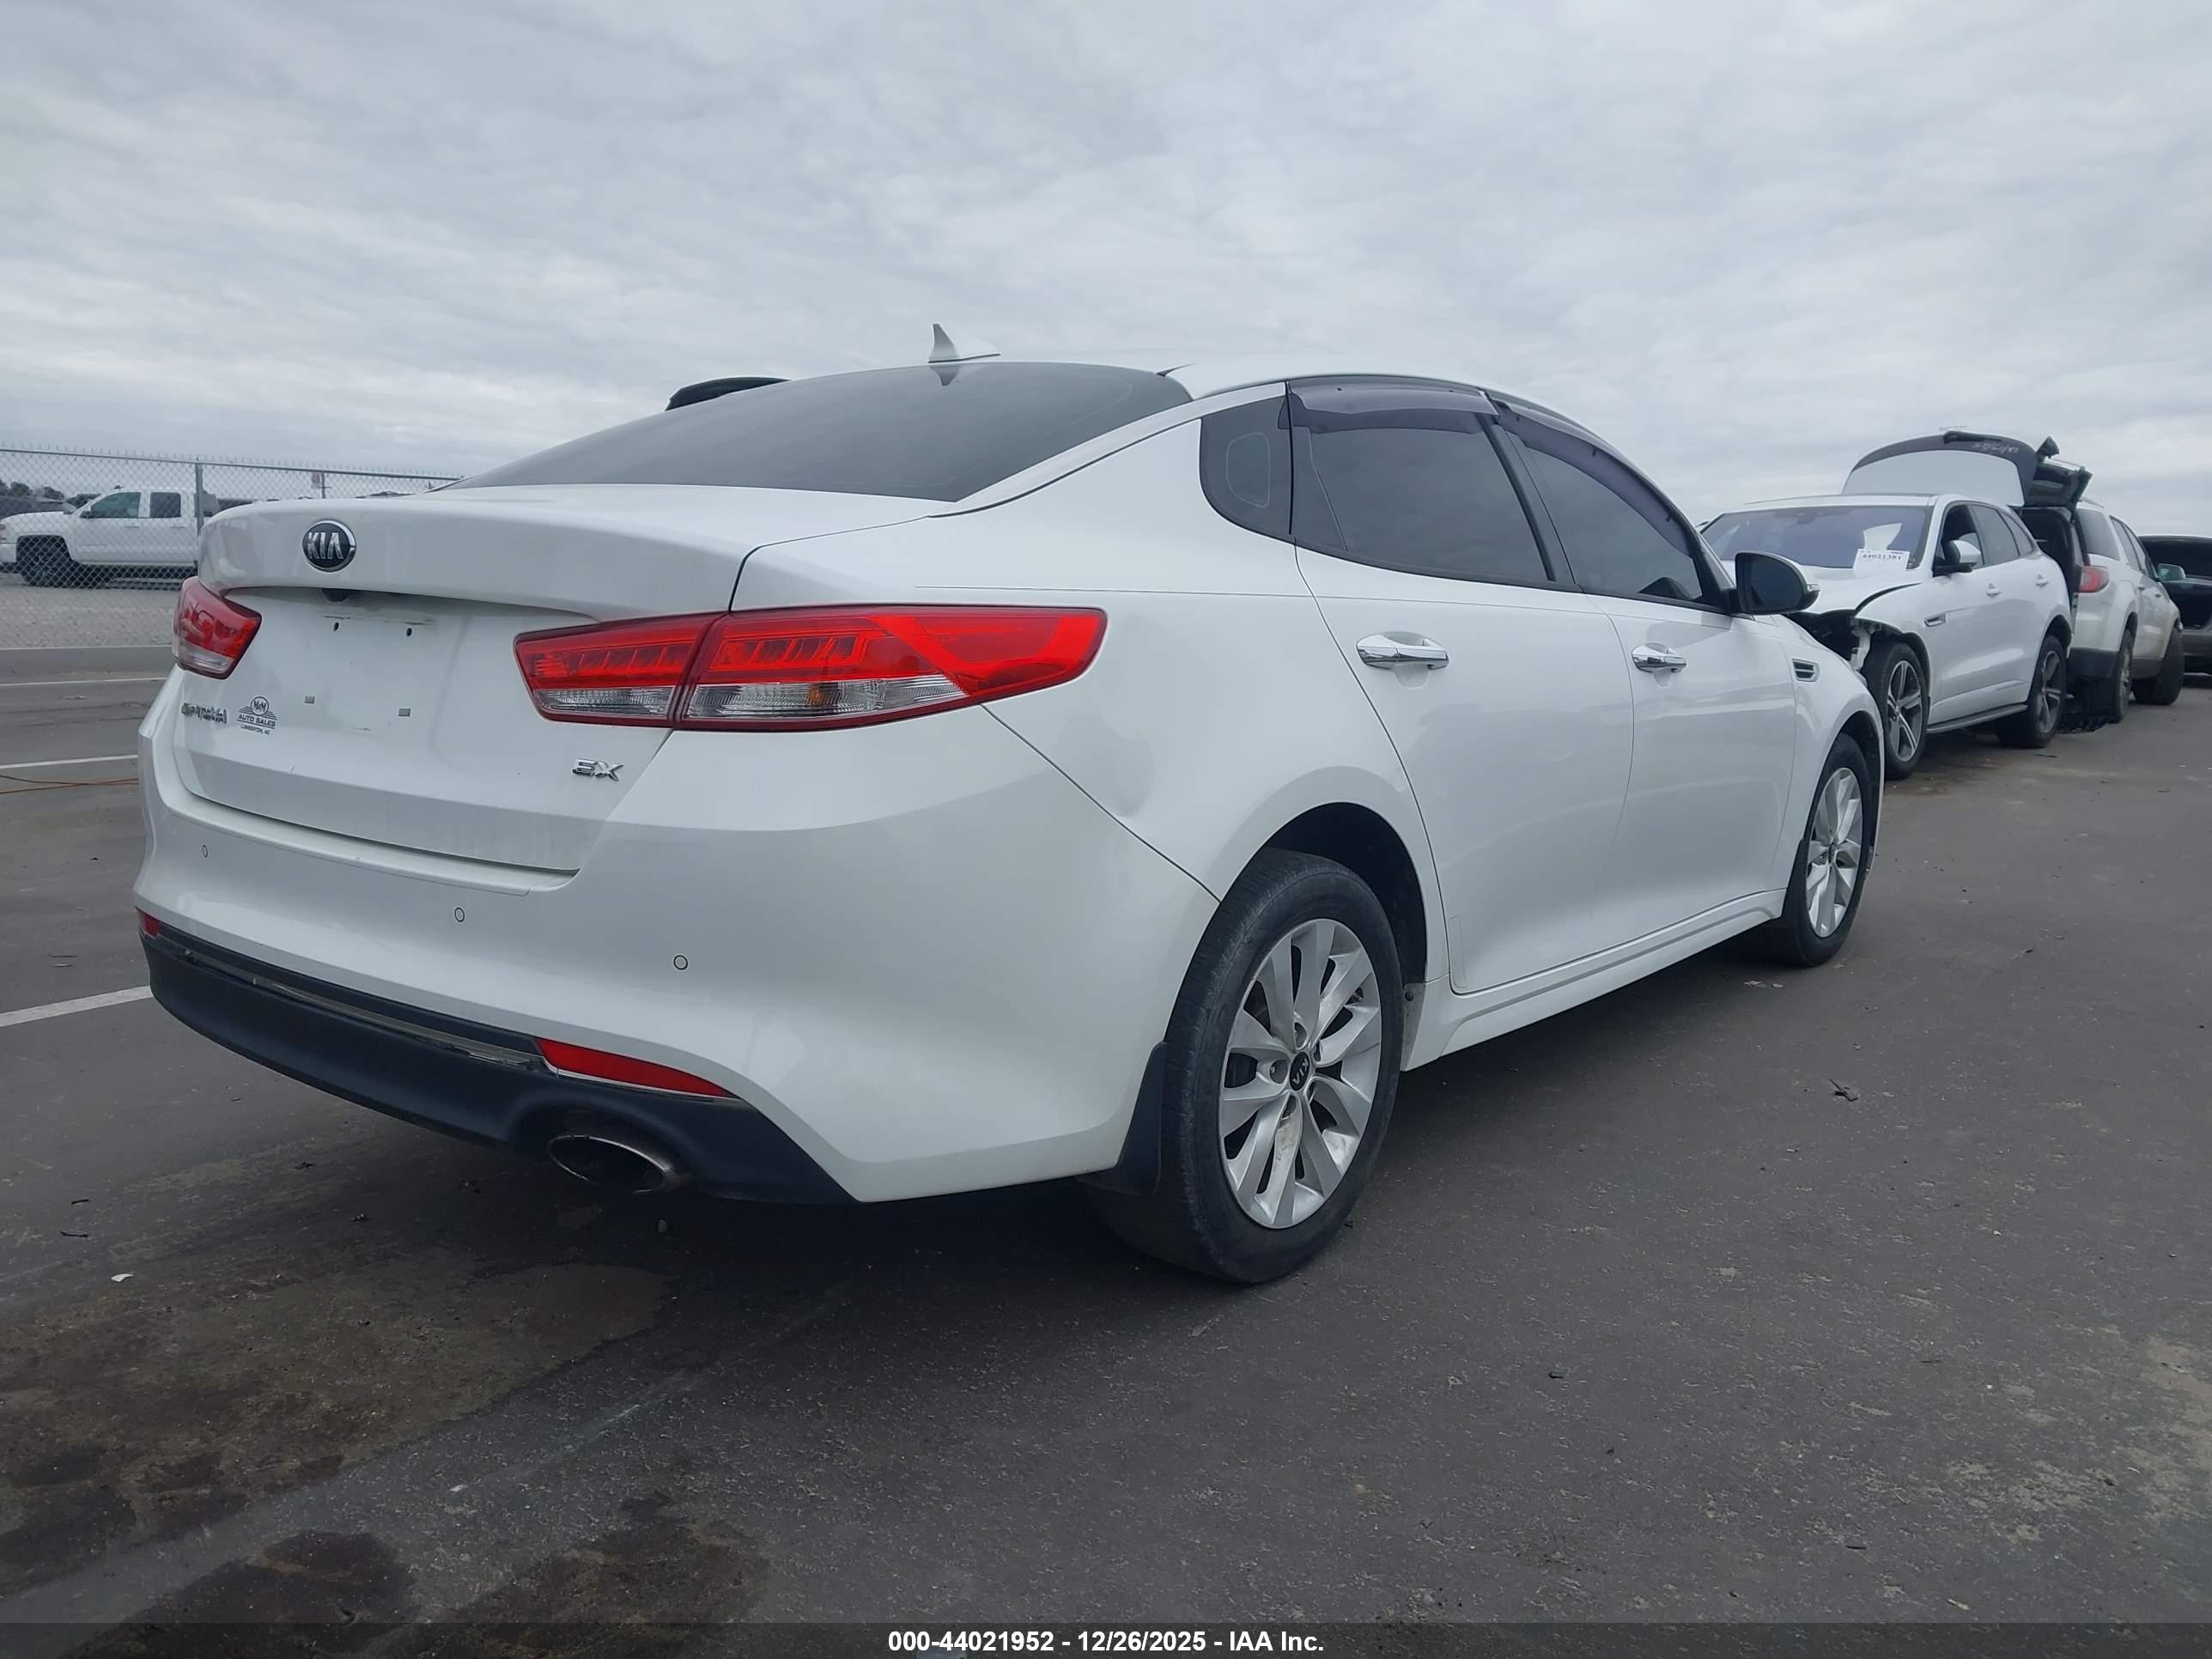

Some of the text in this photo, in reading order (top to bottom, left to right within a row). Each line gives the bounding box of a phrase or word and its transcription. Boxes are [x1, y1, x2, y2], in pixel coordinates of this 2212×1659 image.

[307, 532, 343, 559] KIA
[238, 713, 276, 727] AUTO SALES
[572, 758, 624, 781] EX
[1291, 1057, 1310, 1085] KIA
